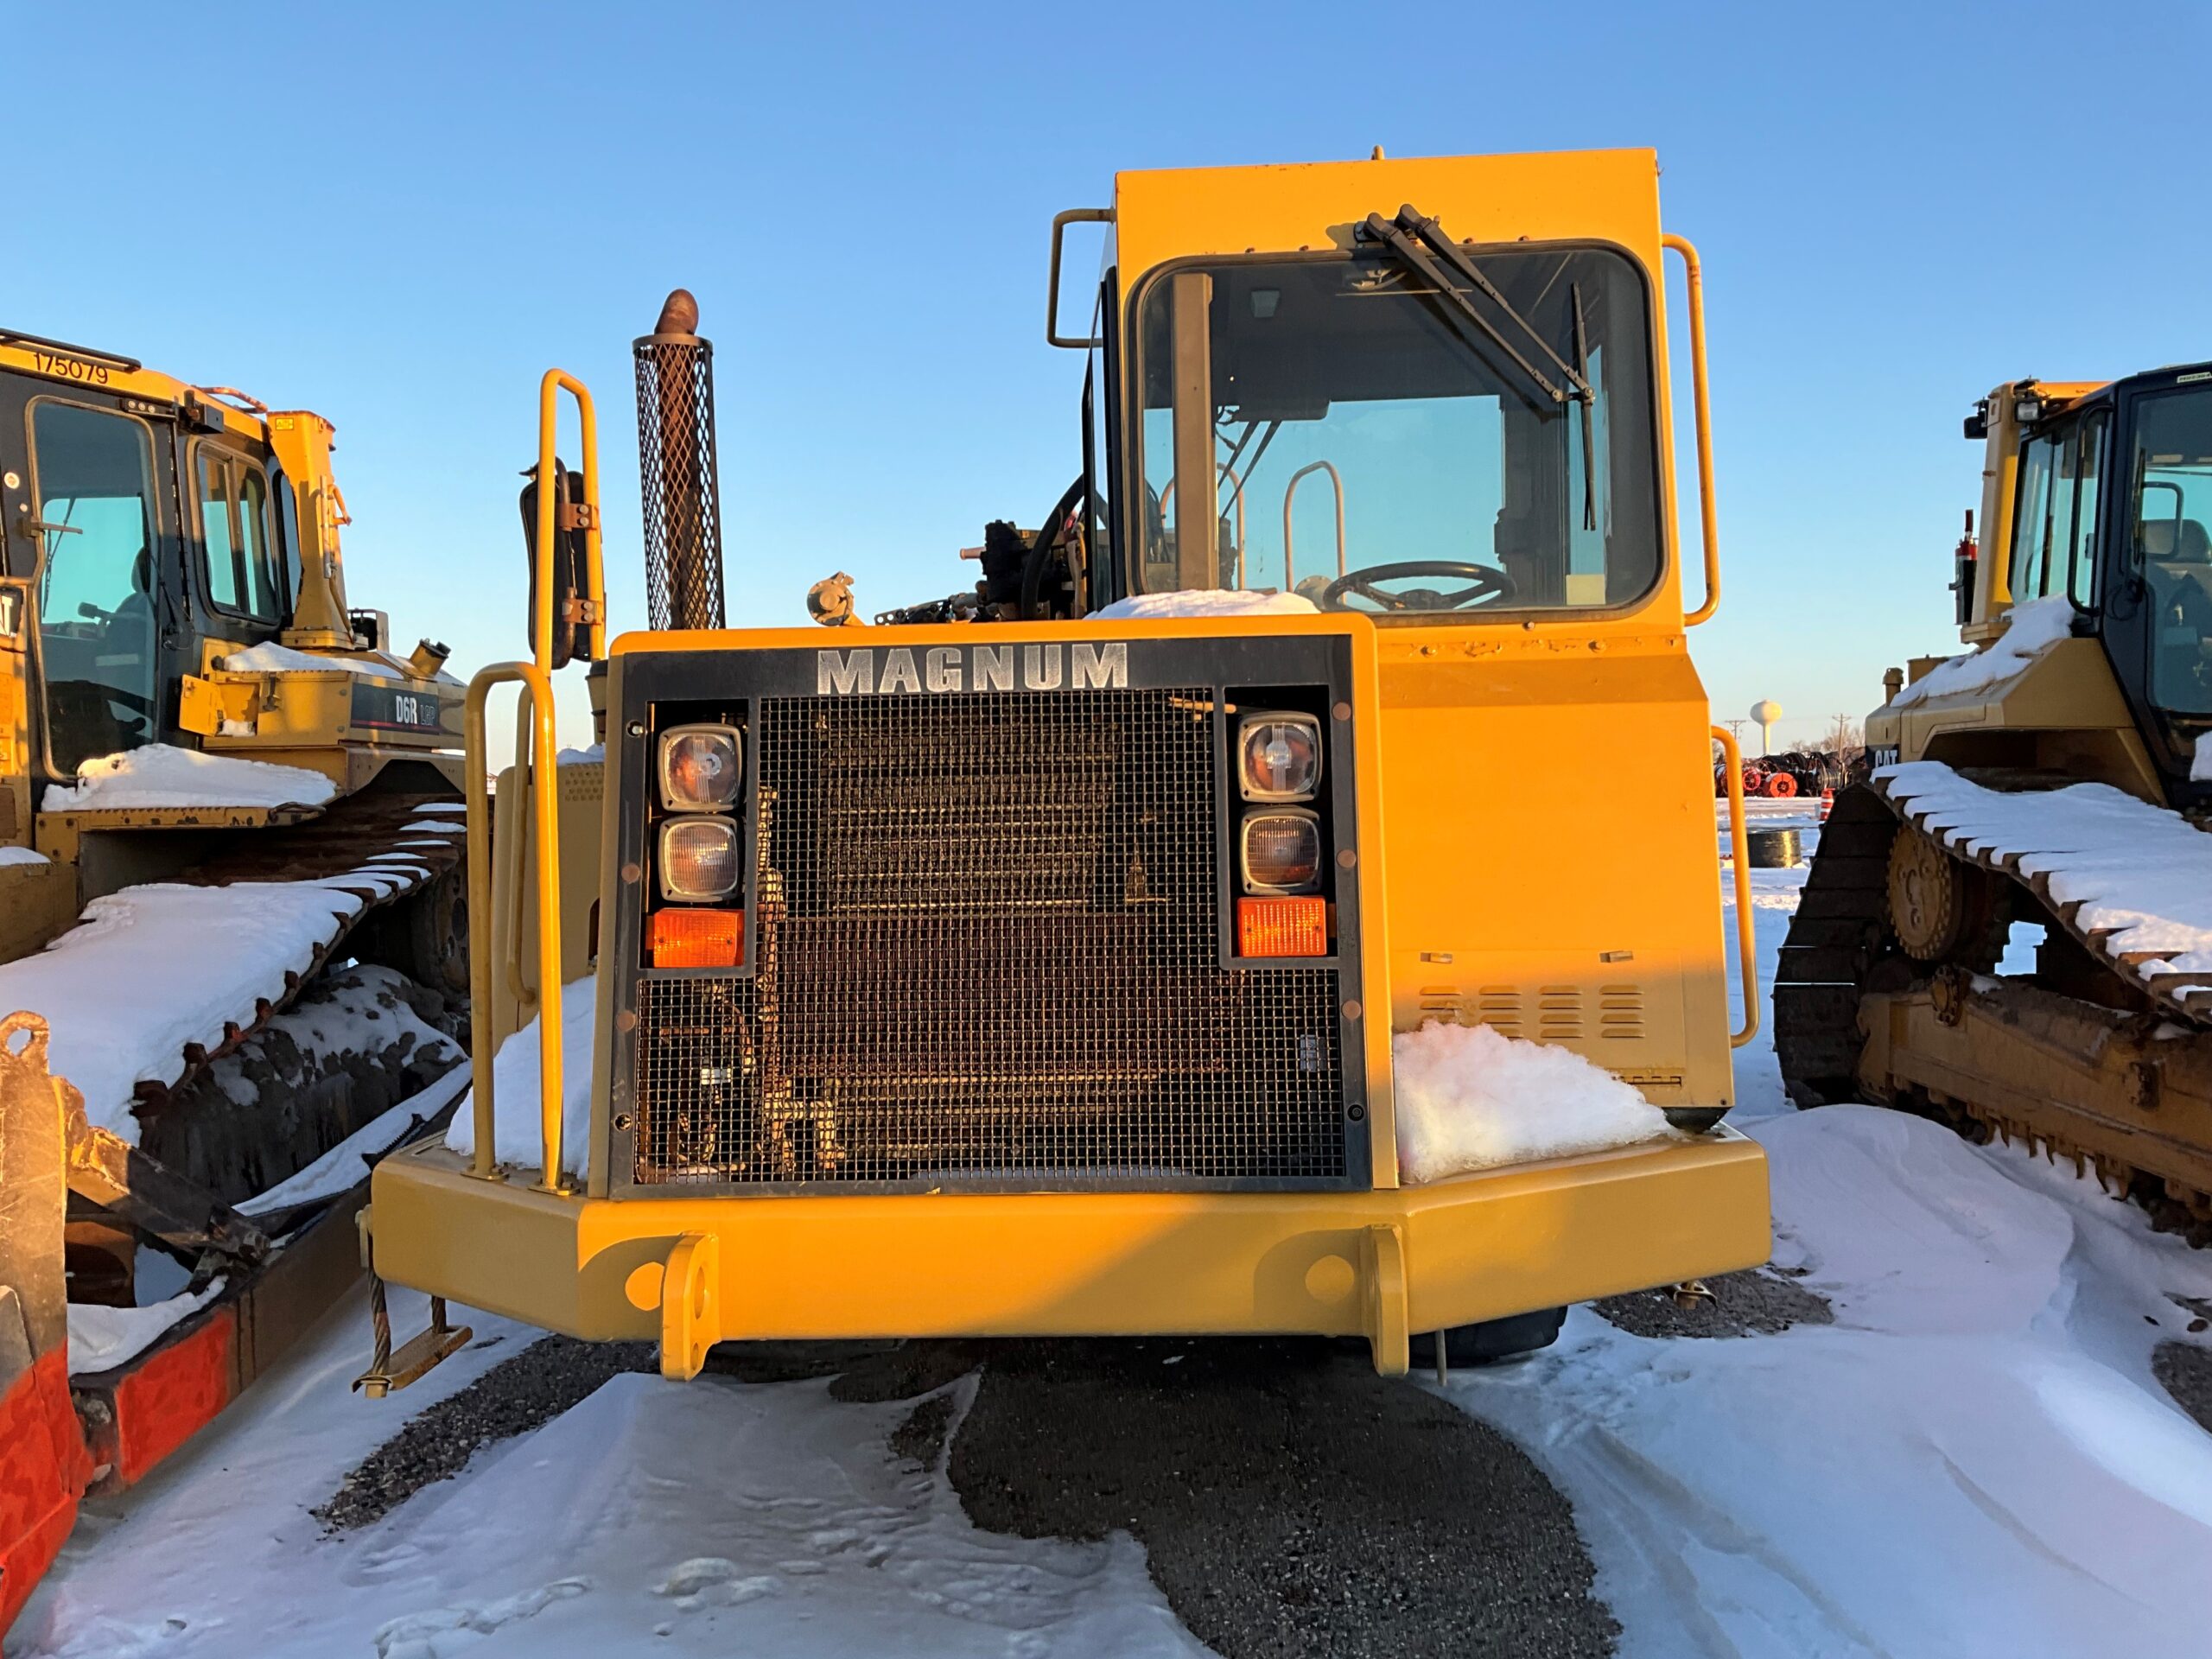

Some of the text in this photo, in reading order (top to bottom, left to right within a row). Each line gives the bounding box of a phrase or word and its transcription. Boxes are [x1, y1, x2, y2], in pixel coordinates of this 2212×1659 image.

[34, 352, 108, 384] 175079
[817, 642, 1128, 695] MAGNUM
[396, 695, 418, 725] D6R
[1875, 749, 1898, 768] CAT
